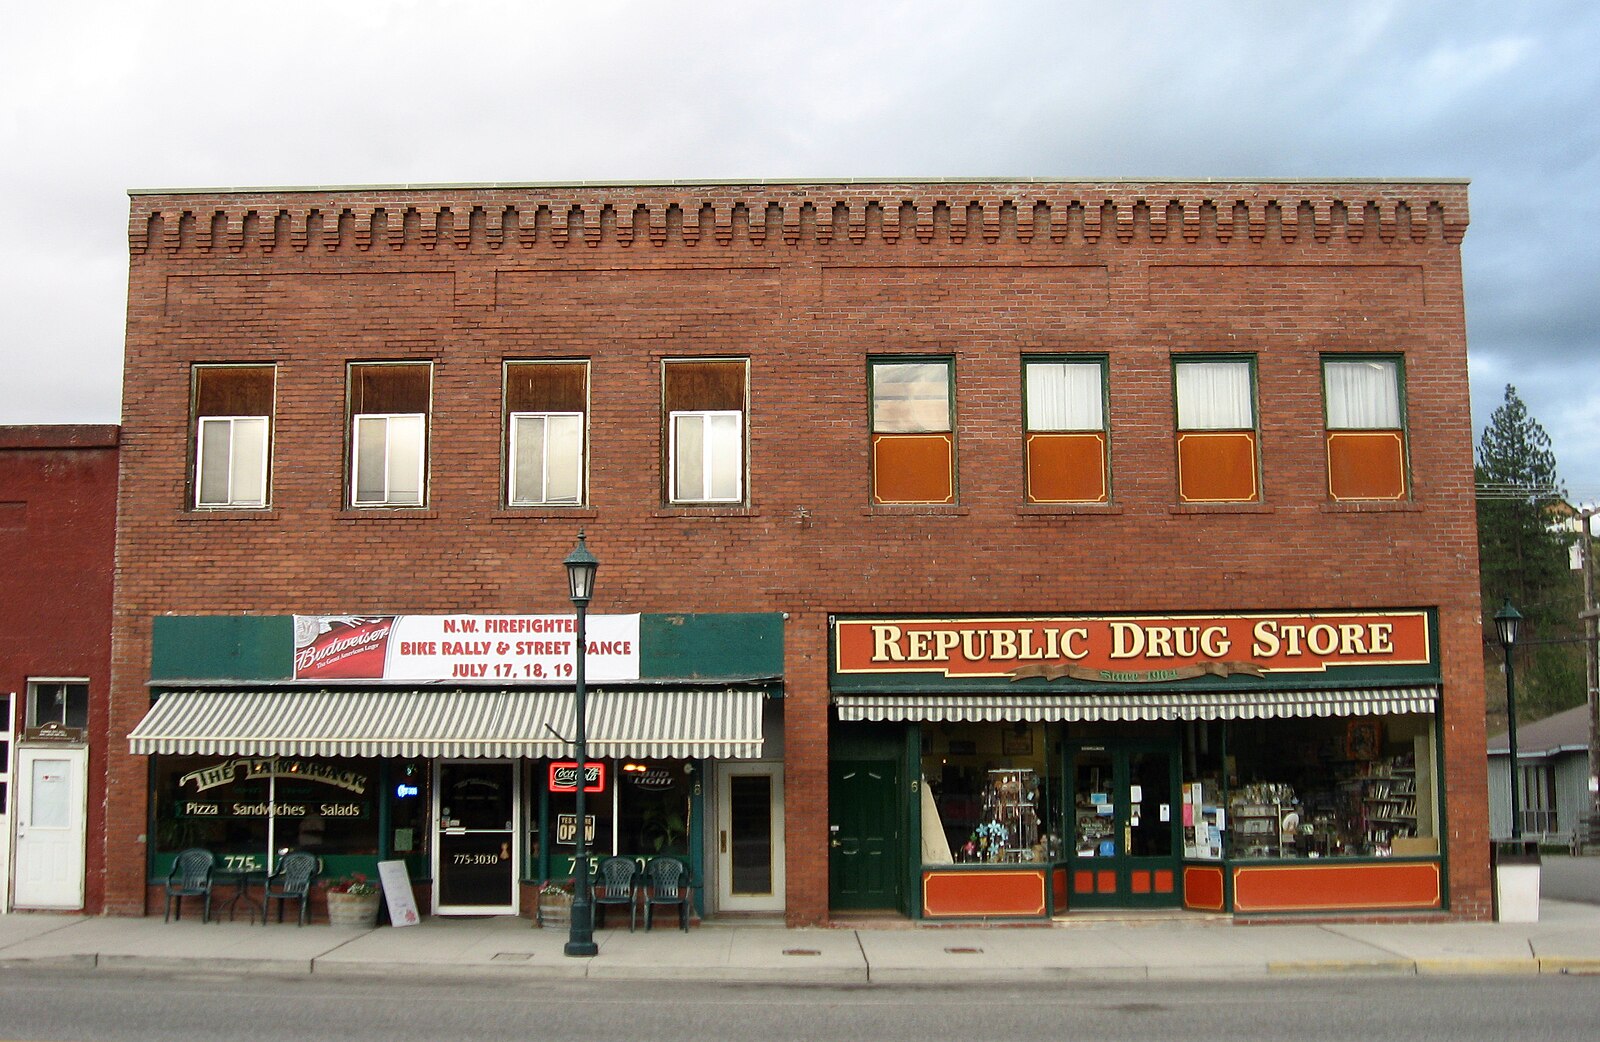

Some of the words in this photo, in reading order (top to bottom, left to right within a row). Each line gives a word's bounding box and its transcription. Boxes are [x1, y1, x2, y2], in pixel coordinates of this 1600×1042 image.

[443, 619, 480, 633] N.W.
[295, 626, 389, 671] Budweiser
[400, 641, 437, 655] BIKE
[442, 641, 491, 655] RALLY
[496, 641, 510, 655] &
[516, 641, 571, 655] STREET
[583, 641, 631, 655] ANCE
[871, 625, 1089, 662] REPUBLIC
[1109, 622, 1231, 659] DRUG
[1253, 620, 1394, 657] STORE
[452, 663, 488, 677] JULY
[494, 663, 517, 678] 17,
[524, 663, 547, 678] 18,
[554, 663, 573, 677] 19
[198, 765, 234, 787] THE
[554, 767, 599, 784] Coca-la
[186, 802, 219, 815] Pizza
[320, 803, 360, 817] Salads
[559, 825, 592, 841] OPN
[453, 854, 498, 864] 775-3030
